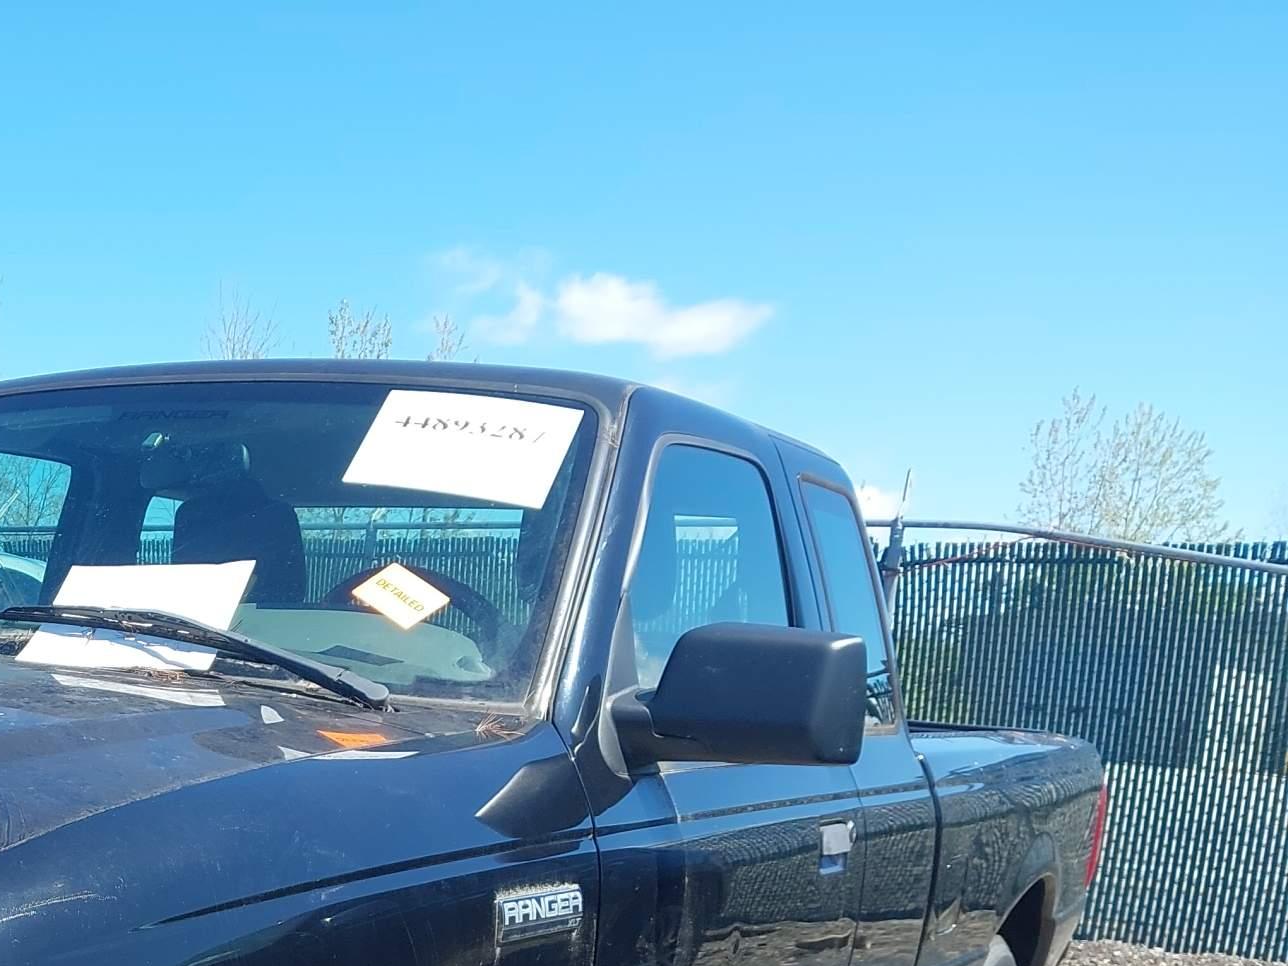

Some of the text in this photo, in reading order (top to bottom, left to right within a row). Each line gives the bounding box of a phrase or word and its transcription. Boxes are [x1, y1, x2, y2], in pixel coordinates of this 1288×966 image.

[375, 578, 425, 612] DETAILED
[503, 890, 583, 926] RANGER
[567, 917, 583, 928] XLT
